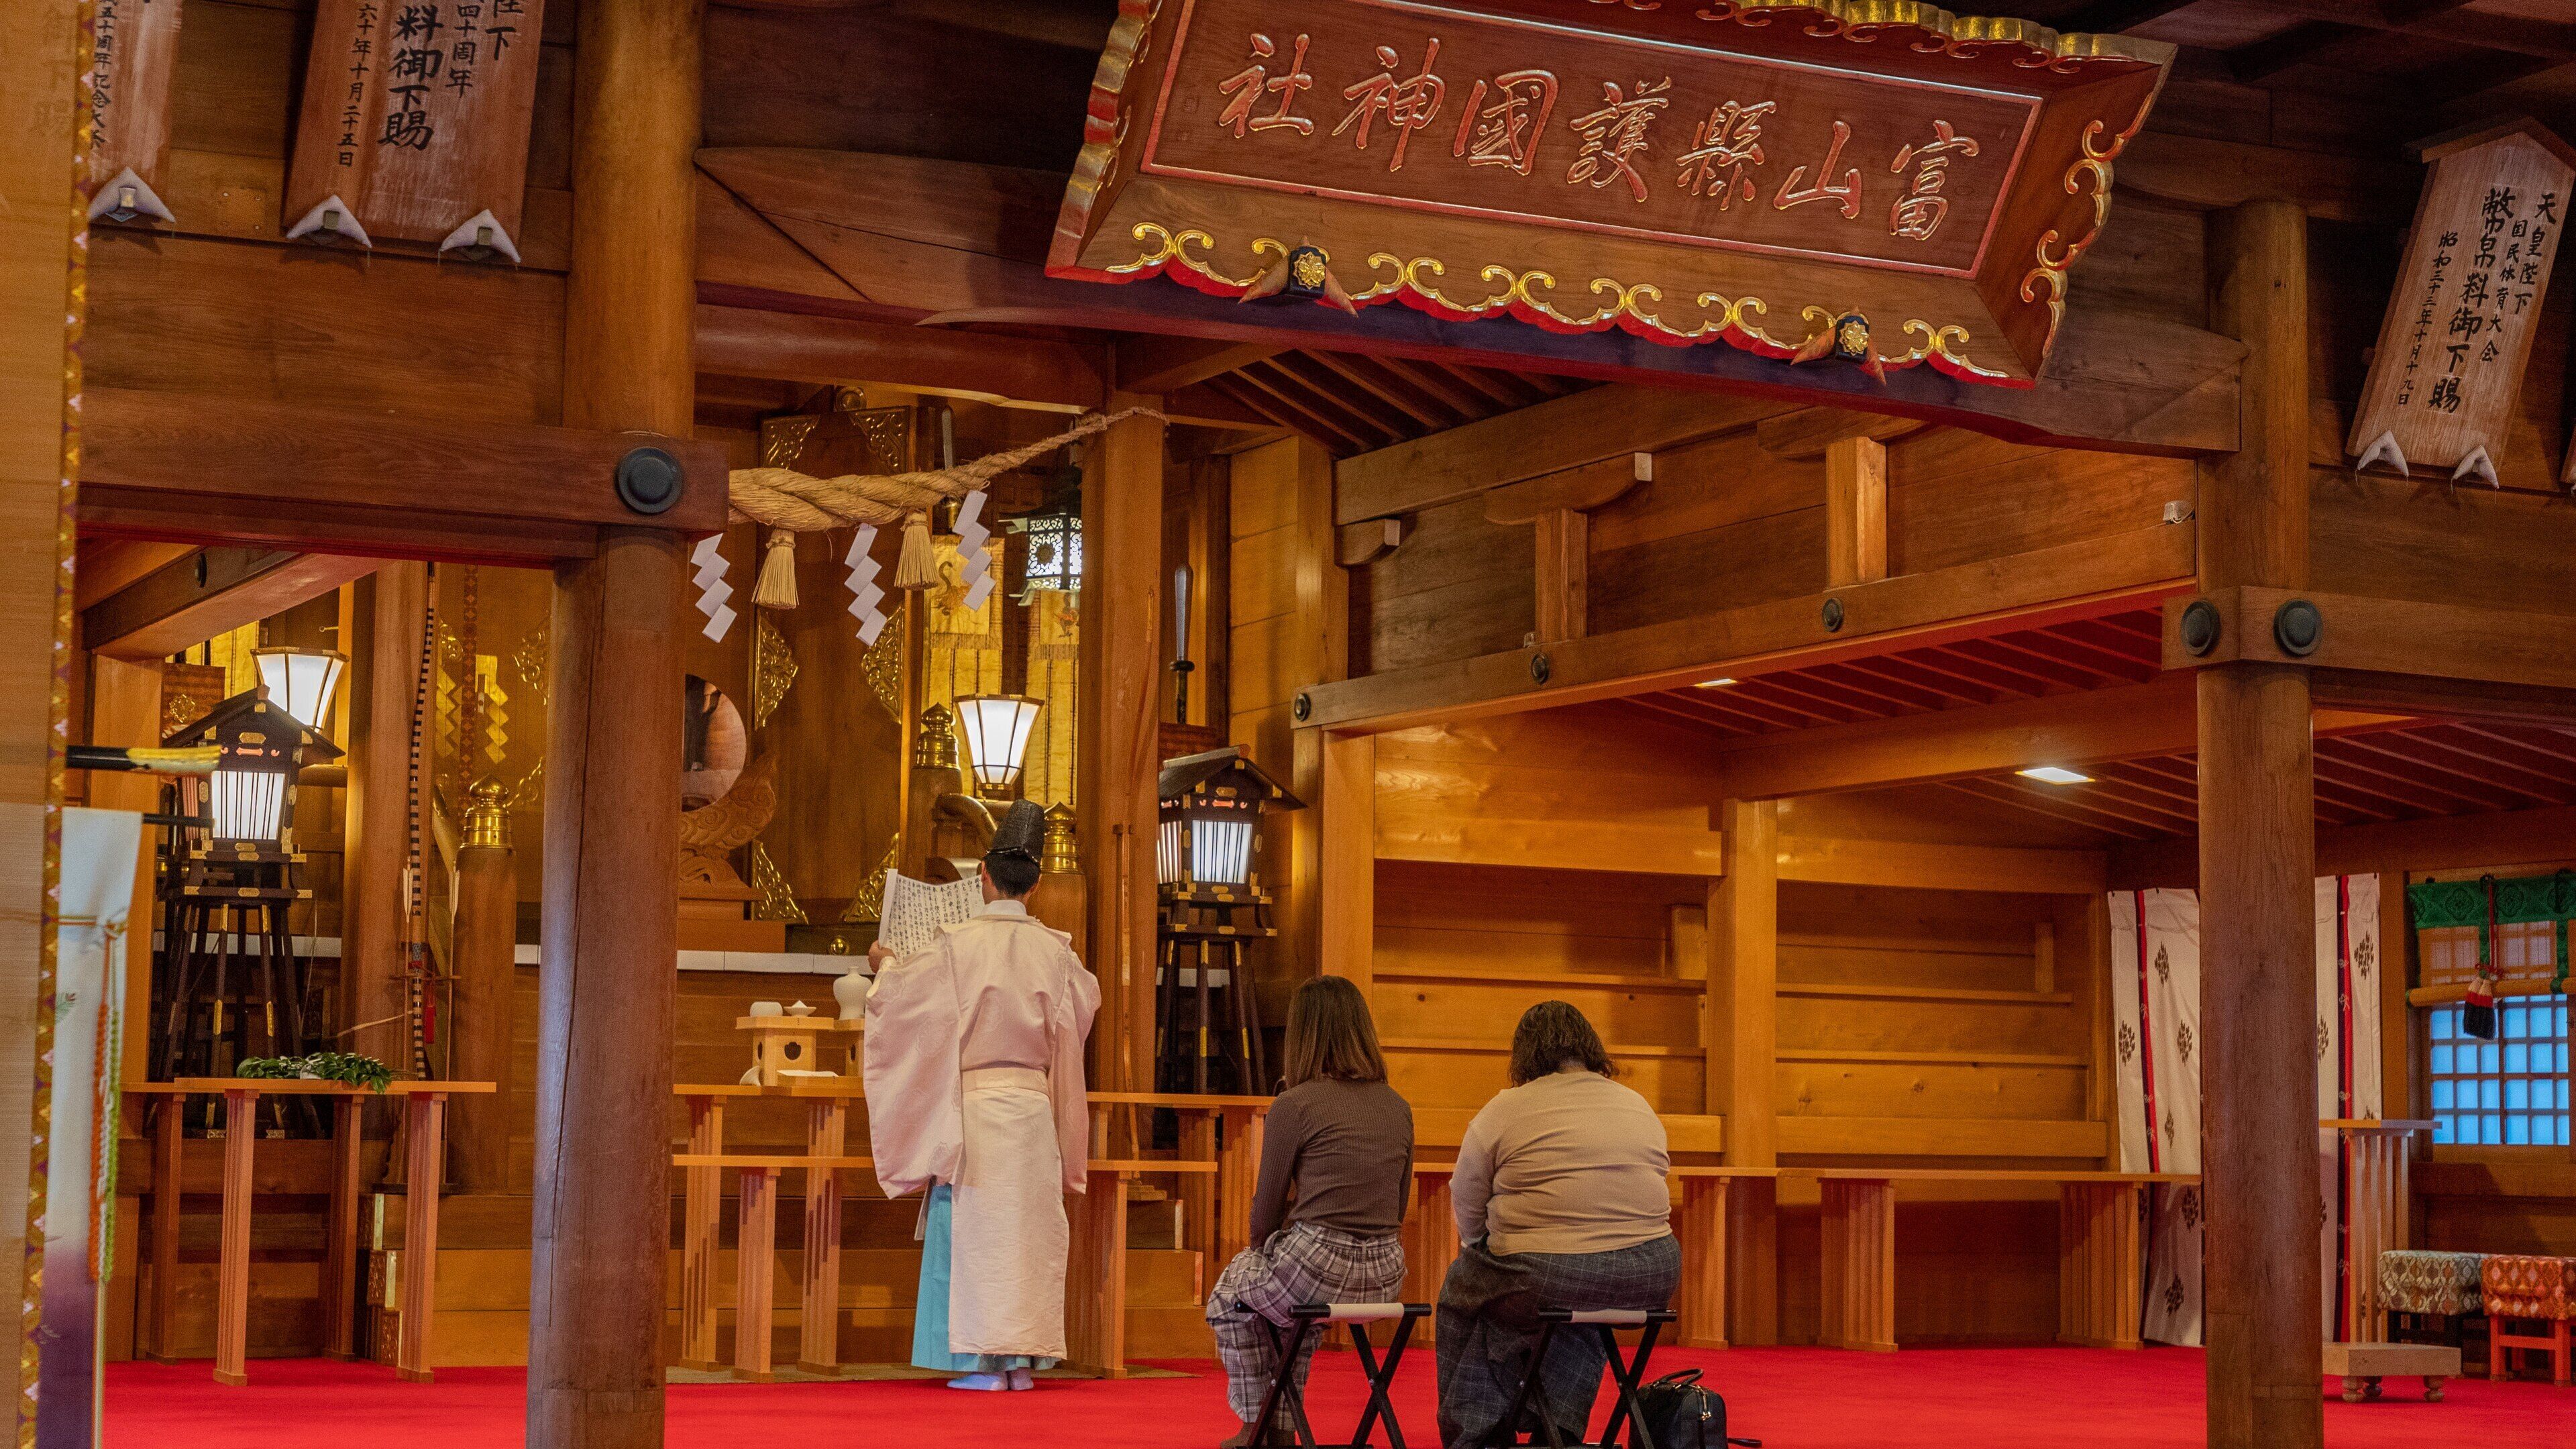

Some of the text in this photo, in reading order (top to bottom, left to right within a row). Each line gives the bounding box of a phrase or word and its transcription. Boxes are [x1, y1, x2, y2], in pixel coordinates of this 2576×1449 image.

[337, 4, 377, 167] 六十年十月二十五日
[377, 5, 444, 151] 料御下賜
[445, 0, 485, 98] 四十周年
[2398, 230, 2459, 405] 昭和三十三年十月十九日
[2428, 186, 2516, 413] 幣帛料御下賜
[2481, 219, 2528, 362] 国民体育大会
[2515, 192, 2557, 315] 天皇陛下
